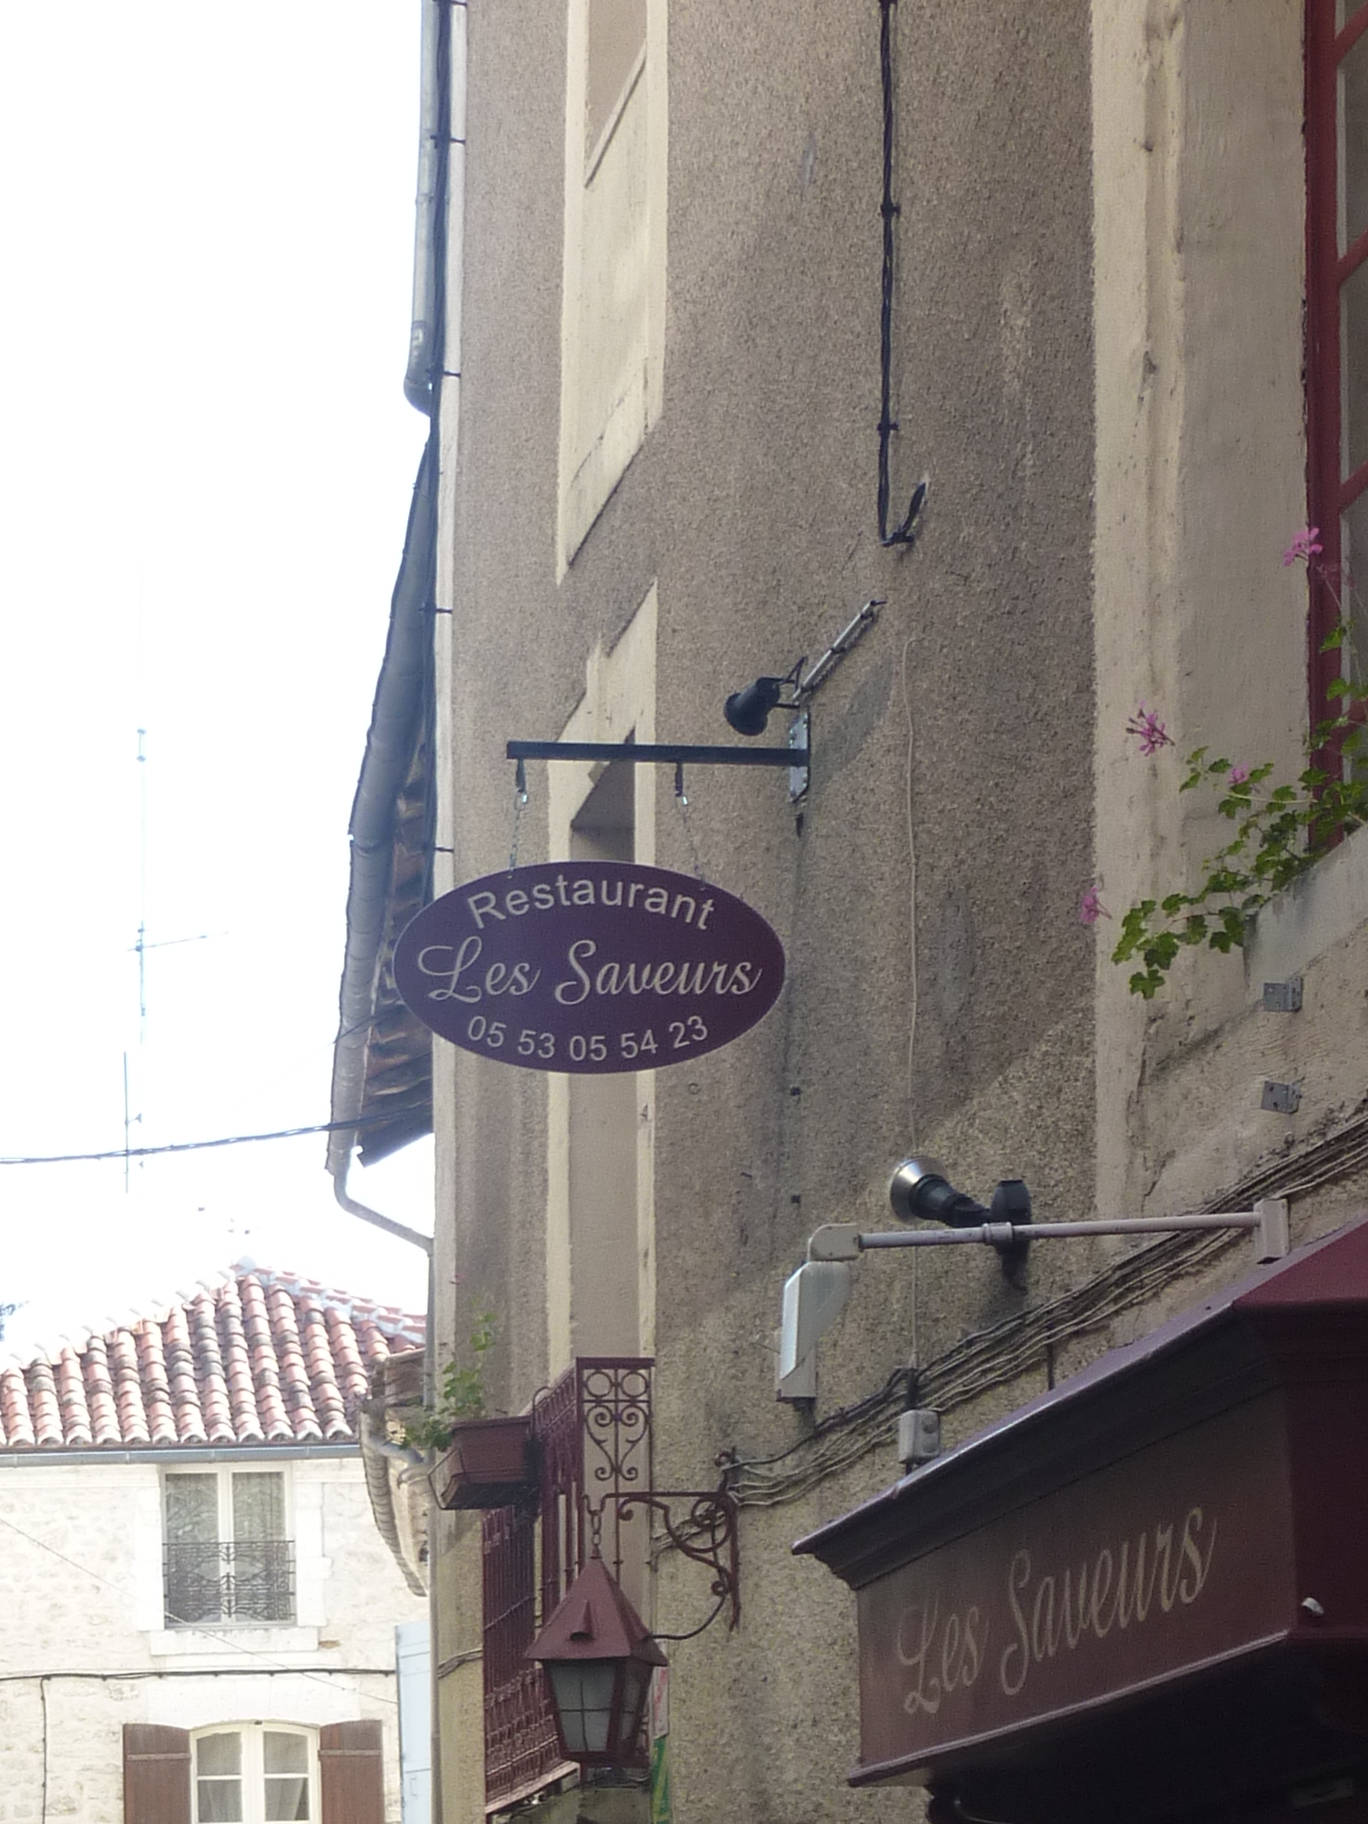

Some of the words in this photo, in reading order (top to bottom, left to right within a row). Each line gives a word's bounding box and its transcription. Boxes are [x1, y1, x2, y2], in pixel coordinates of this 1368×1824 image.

[468, 874, 715, 930] Restaurant
[417, 936, 541, 1003] Les
[554, 939, 763, 1005] Saveurs
[468, 1016, 507, 1048] 05
[518, 1032, 555, 1059] 53
[570, 1036, 607, 1061] 05
[621, 1029, 658, 1059] 54
[669, 1015, 708, 1048] 23
[897, 1592, 989, 1715] Les
[1000, 1507, 1217, 1695] Saveurs
